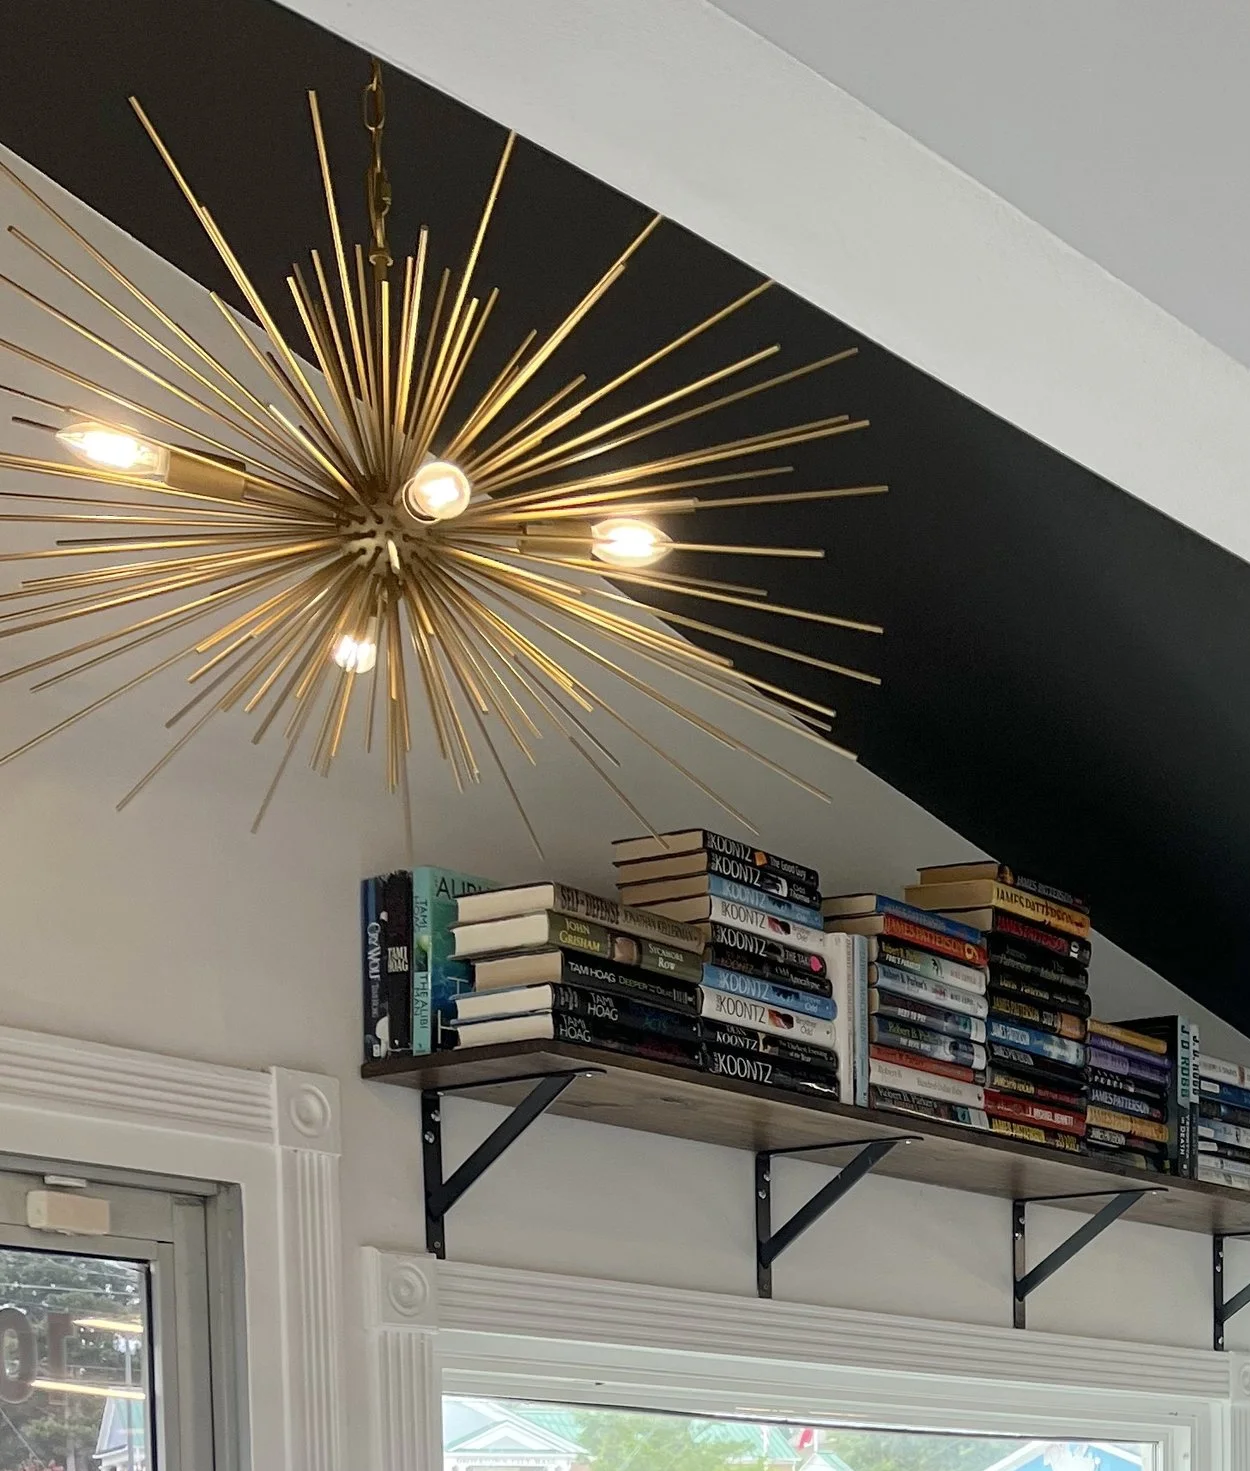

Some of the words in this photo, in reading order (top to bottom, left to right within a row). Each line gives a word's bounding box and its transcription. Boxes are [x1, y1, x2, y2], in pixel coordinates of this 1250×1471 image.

[710, 833, 752, 862] KOONTZ
[715, 856, 761, 887] KOONTZ
[995, 887, 1024, 906] JAMES
[419, 897, 429, 929] TAMI
[725, 903, 767, 929] KOONTZ
[564, 917, 591, 935] JOHN
[559, 930, 601, 953] GRISHAM
[720, 926, 768, 957] KOONTZ
[567, 961, 589, 976] TAMI
[589, 967, 617, 984] HOAG
[658, 957, 676, 971] ROW
[419, 973, 429, 997] THE
[723, 972, 770, 1001] KOONTZ
[590, 992, 615, 1008] TAMI
[720, 995, 767, 1025] KOONTZ
[419, 999, 429, 1030] ALIBI
[560, 1013, 586, 1029] TAMI
[587, 1002, 619, 1022] HOAG
[559, 1024, 592, 1043] HOAG
[716, 1031, 759, 1051] KOONTZ
[719, 1052, 773, 1085] KOONTZ
[1112, 1095, 1151, 1115] PATTERSON
